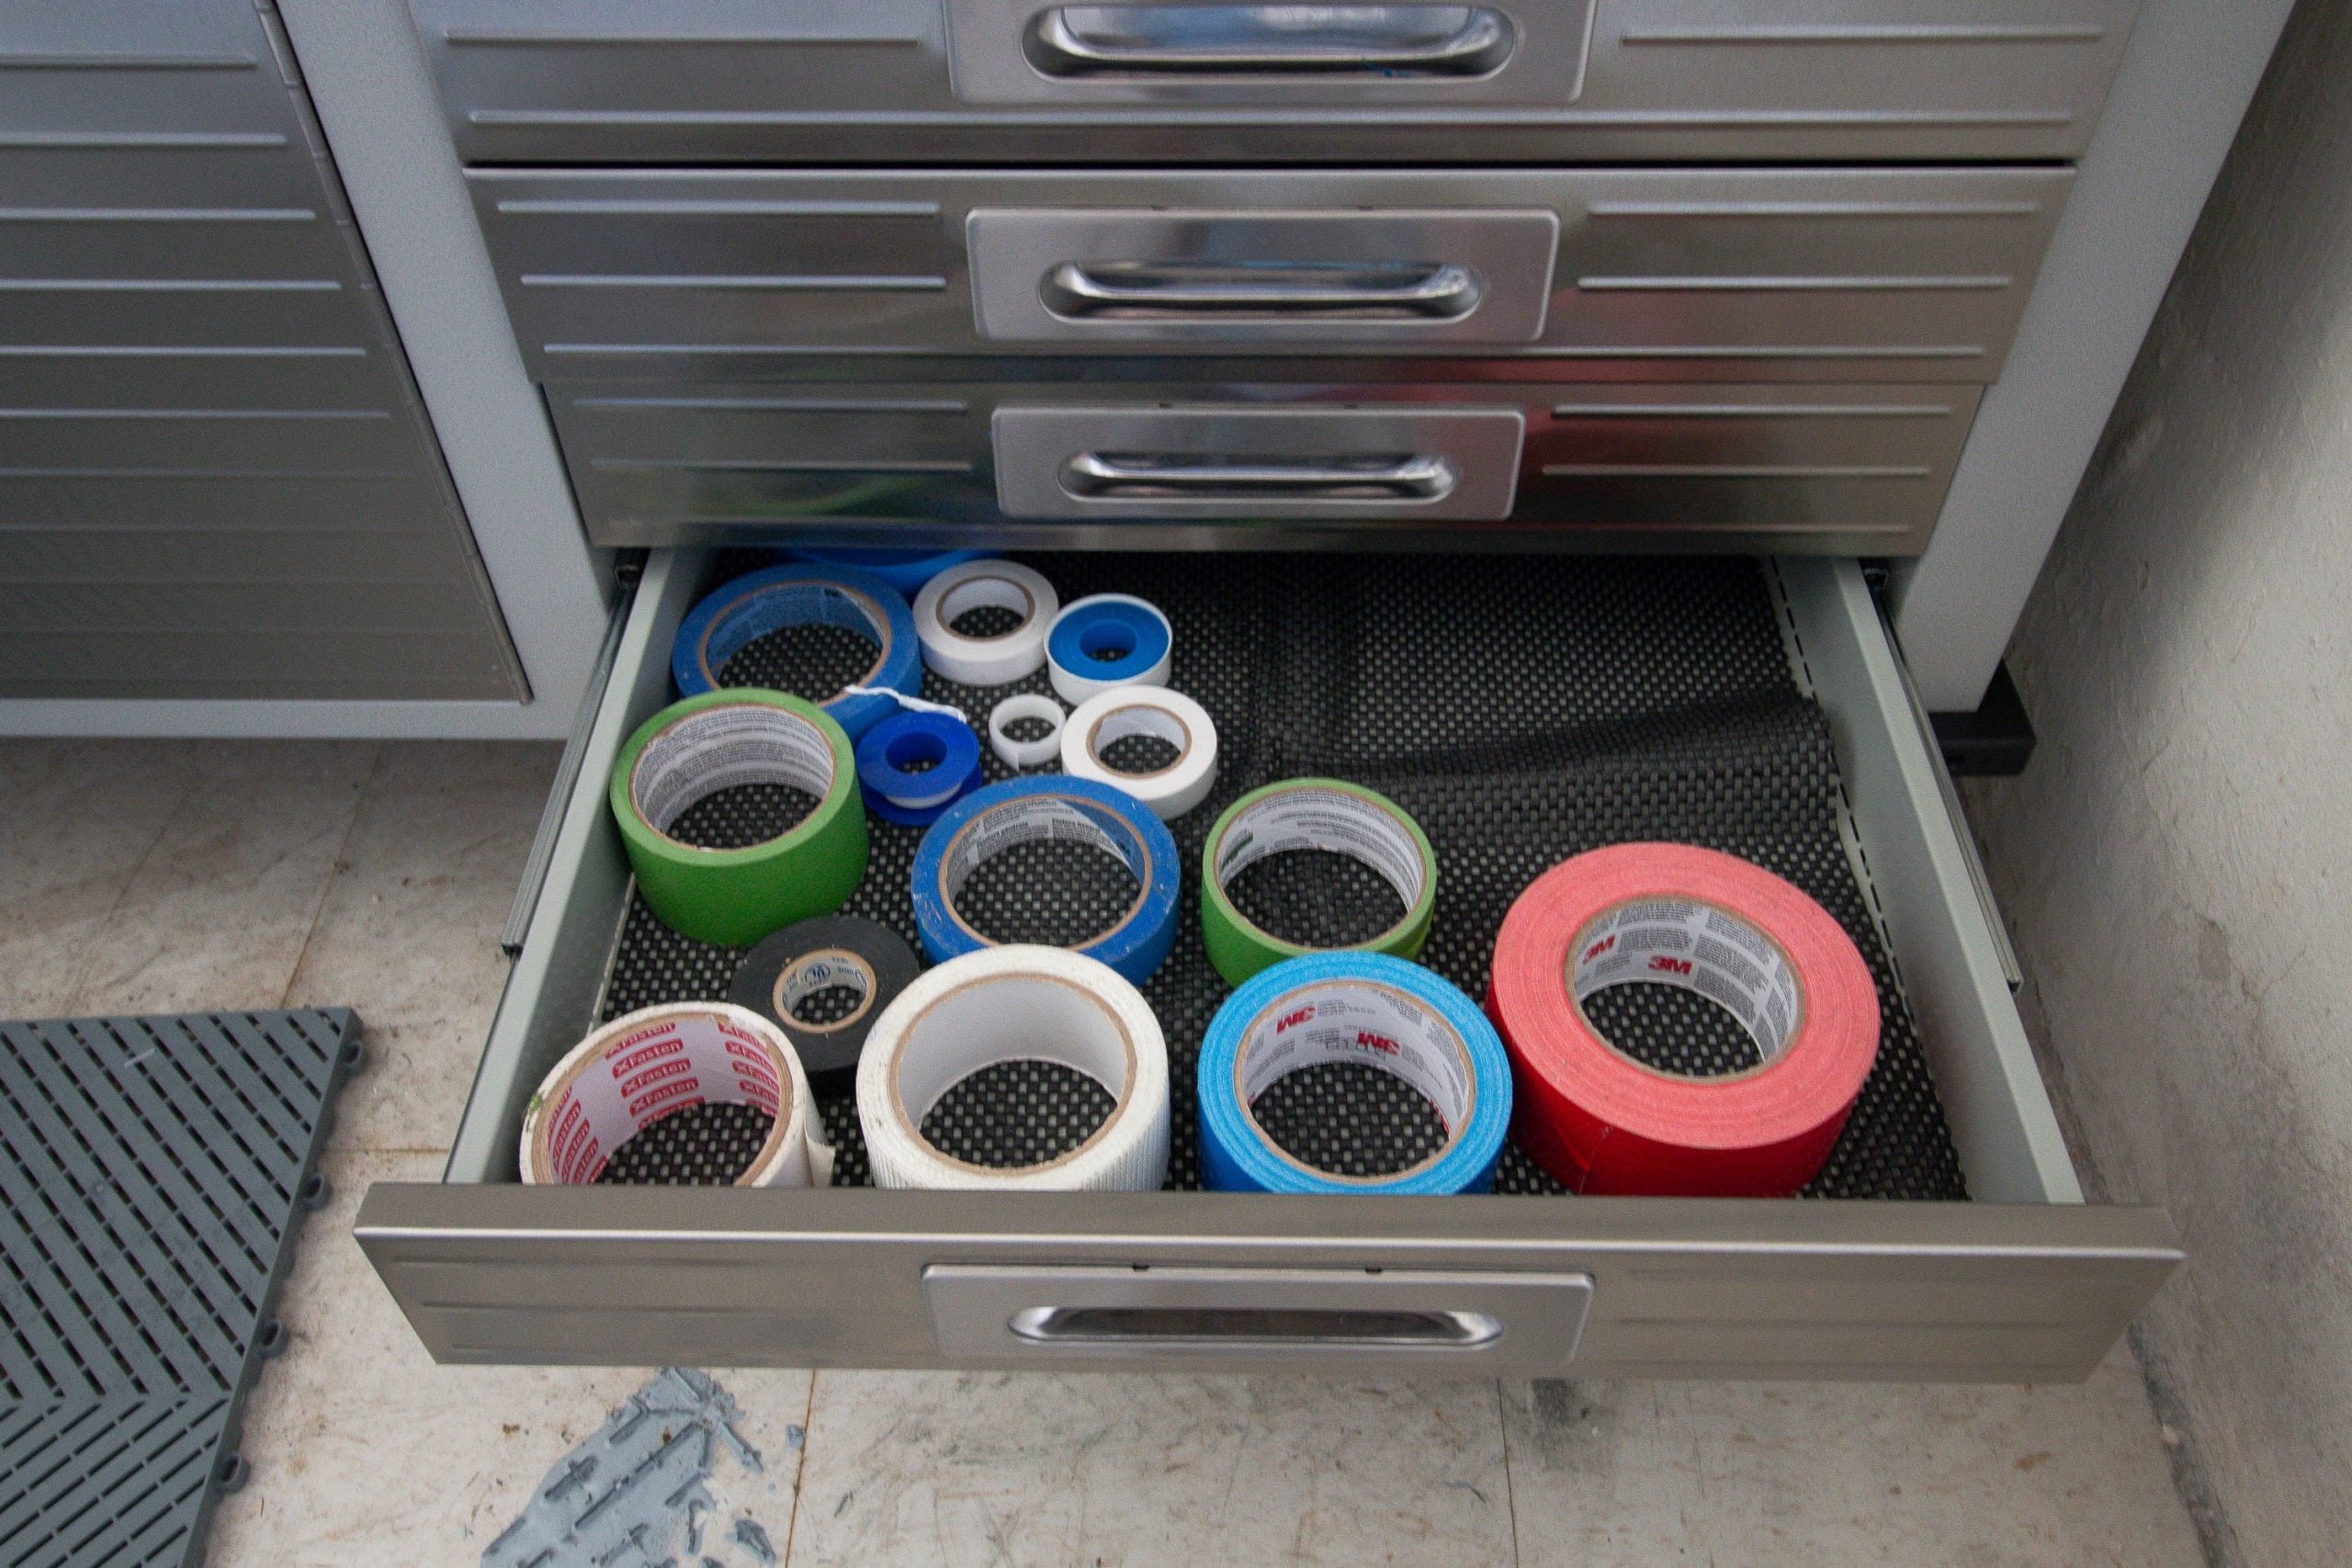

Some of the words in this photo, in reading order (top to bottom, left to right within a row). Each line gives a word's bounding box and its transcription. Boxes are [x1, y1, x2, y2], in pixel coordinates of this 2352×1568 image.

[1583, 936, 1615, 964] 3M
[1648, 954, 1692, 976] 3M
[1276, 1007, 1316, 1035] 3M
[1357, 1030, 1400, 1055] 3M
[616, 1040, 682, 1076] XFasten
[625, 1059, 690, 1096] XFasten
[633, 1078, 697, 1114] XFasten
